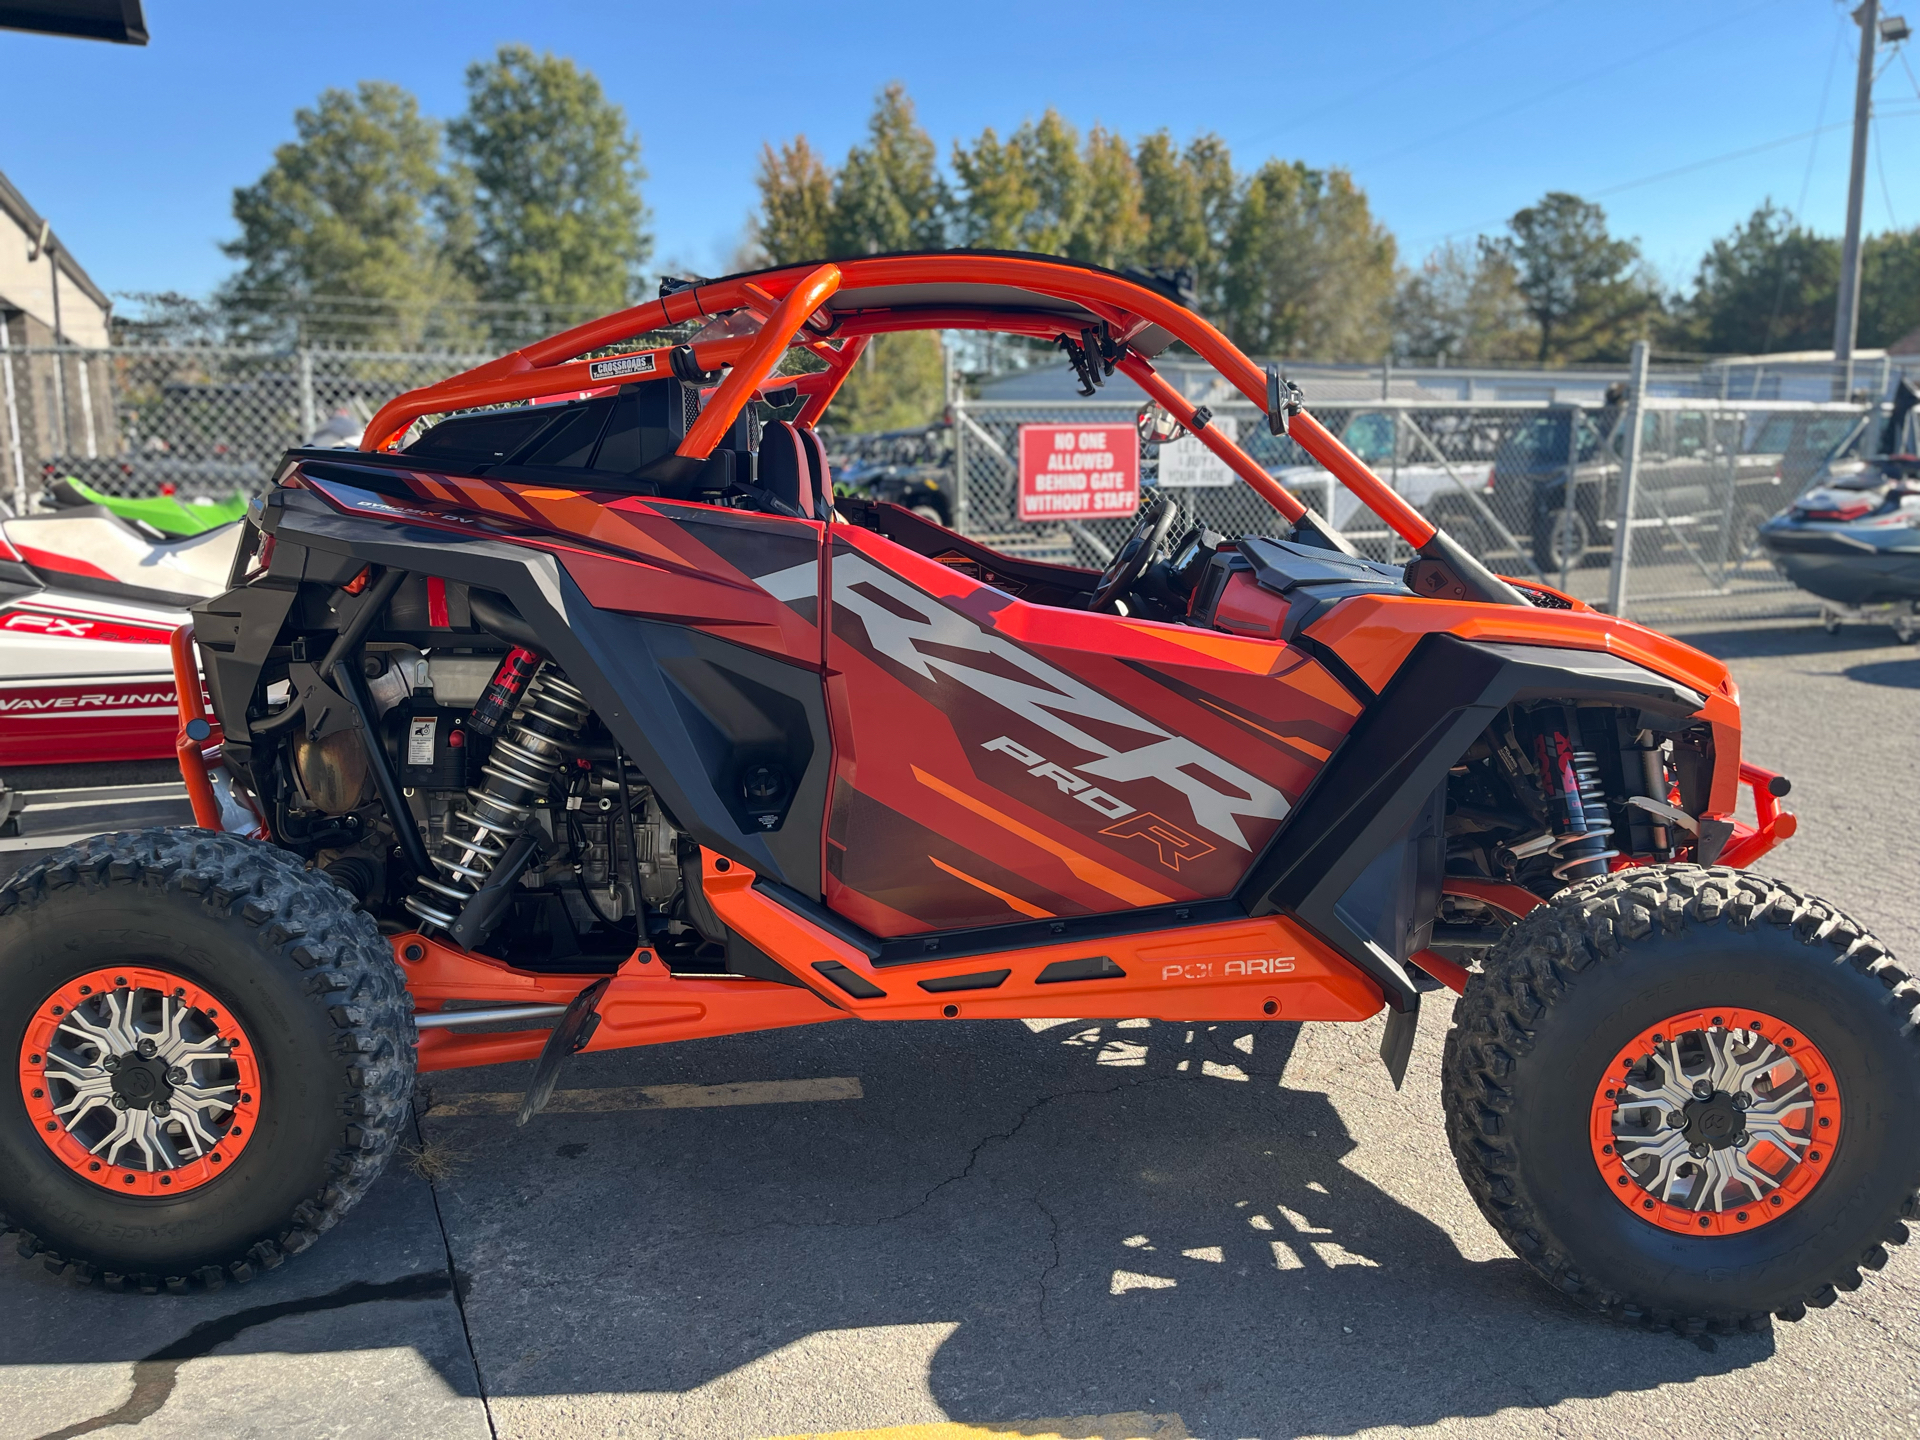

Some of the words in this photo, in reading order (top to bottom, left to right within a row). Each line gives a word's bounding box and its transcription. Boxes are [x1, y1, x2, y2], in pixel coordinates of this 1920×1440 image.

[597, 357, 646, 374] CROSSROADS
[1054, 432, 1076, 451] NO
[1078, 432, 1107, 450] ONE
[1047, 452, 1114, 471] ALLOWED
[1035, 473, 1087, 491] BEHIND
[1090, 472, 1125, 490] GATE
[1025, 492, 1090, 512] WITHOUT
[1093, 491, 1134, 510] STAFF
[5, 614, 94, 636] FX
[753, 552, 1292, 853] RZR
[981, 736, 1137, 819] PRO
[1098, 812, 1216, 872] R
[1162, 956, 1296, 981] POLARIS
